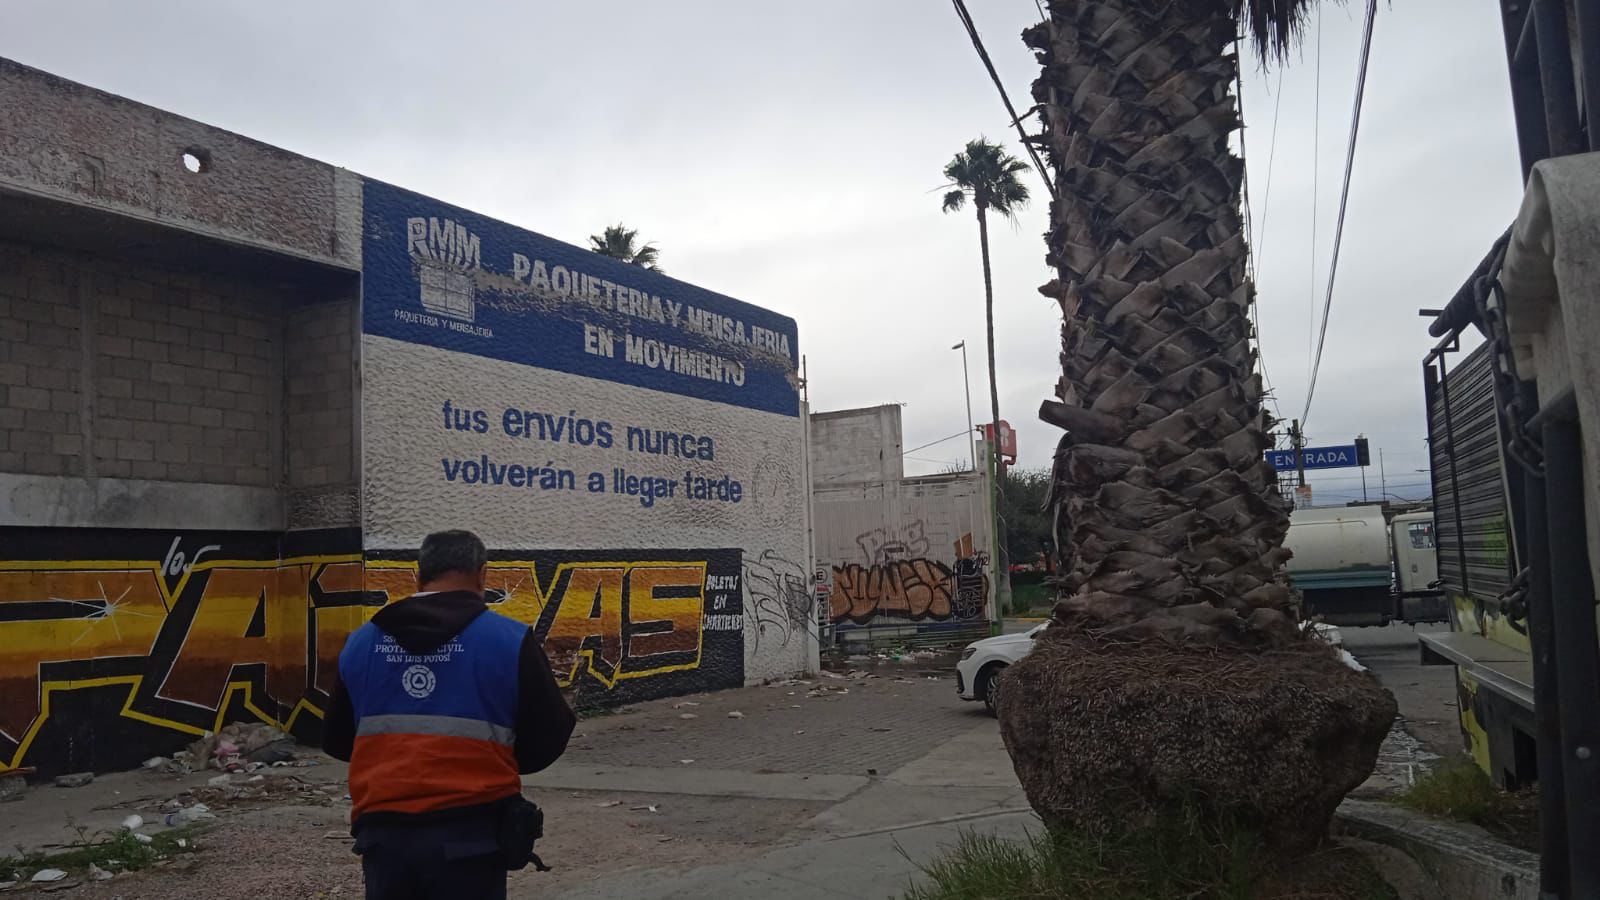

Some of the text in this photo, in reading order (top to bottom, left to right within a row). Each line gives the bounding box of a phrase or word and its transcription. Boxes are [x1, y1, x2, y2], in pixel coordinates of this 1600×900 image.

[408, 216, 480, 271] RMM
[394, 309, 494, 338] PAQUETERIA Y MENSAJERIA
[513, 253, 791, 359] PAQUETERIA Y MENSAJERIA
[584, 323, 745, 387] EN MOVIMIENTO
[442, 400, 714, 462] tus envíos nunca
[442, 454, 743, 508] volverán a llegar tarde
[1274, 451, 1348, 467] ENRADA
[713, 593, 728, 610] EN
[386, 654, 403, 663] SAN
[405, 655, 423, 663] LUIS
